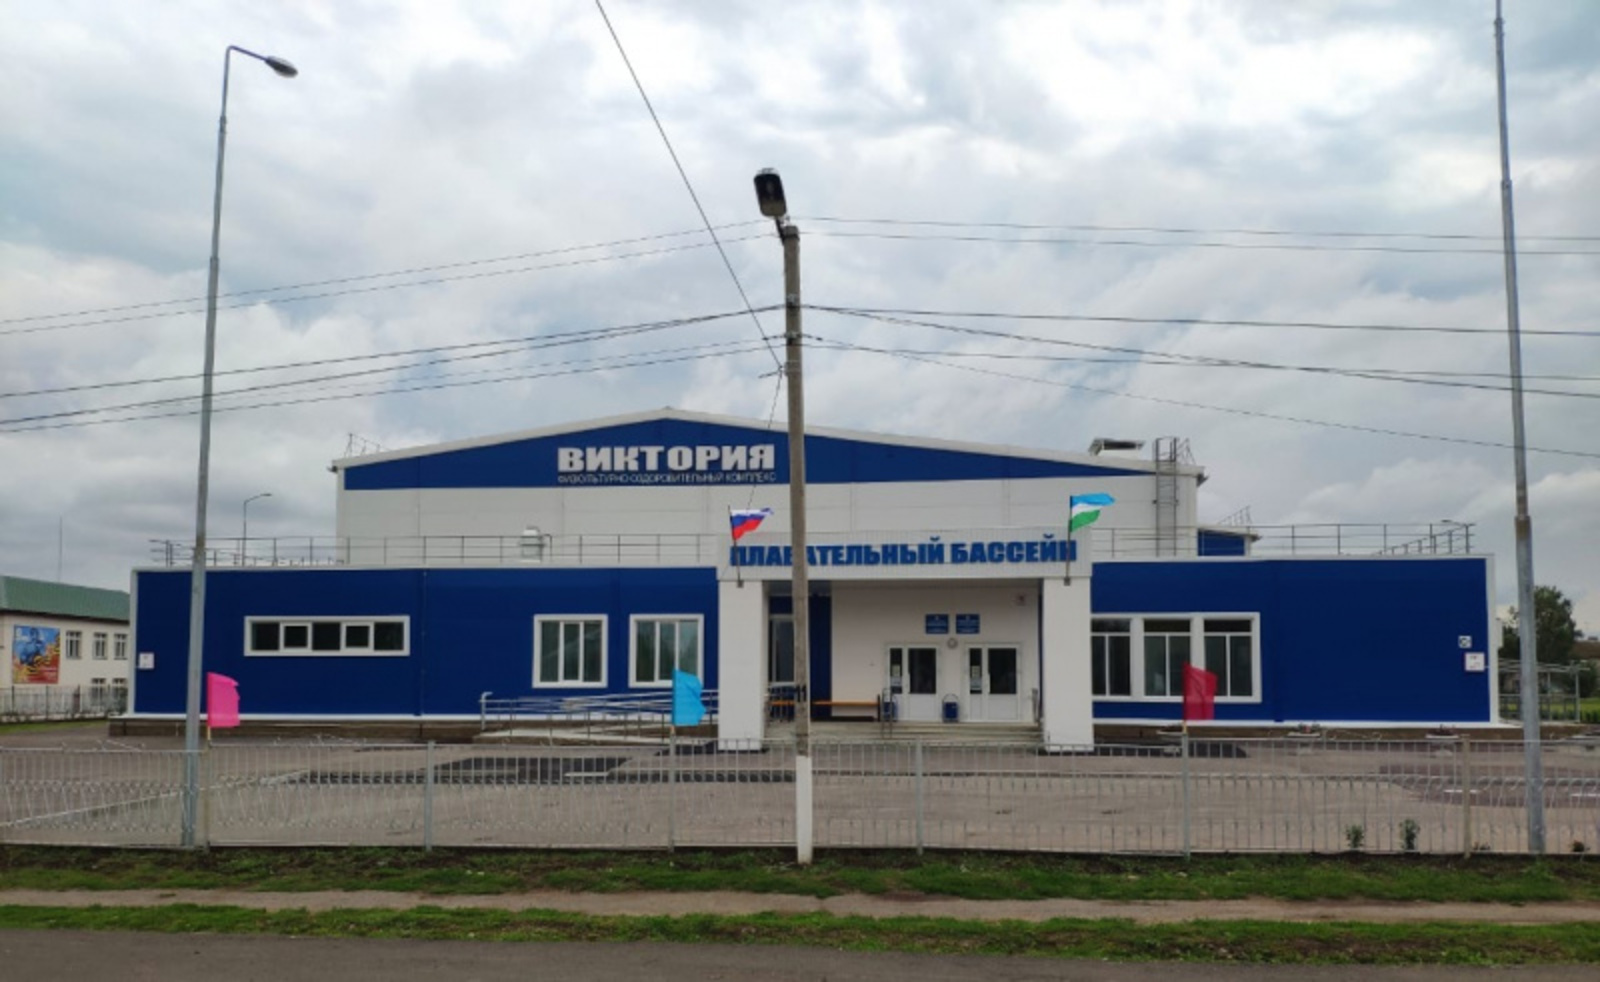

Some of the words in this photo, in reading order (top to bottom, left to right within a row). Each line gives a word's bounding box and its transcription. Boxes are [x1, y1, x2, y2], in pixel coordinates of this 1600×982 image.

[557, 444, 775, 473] ВИКТОРИЯ
[725, 472, 777, 483] КОМПЛЕКС
[950, 533, 1077, 563] БАССЕЙН
